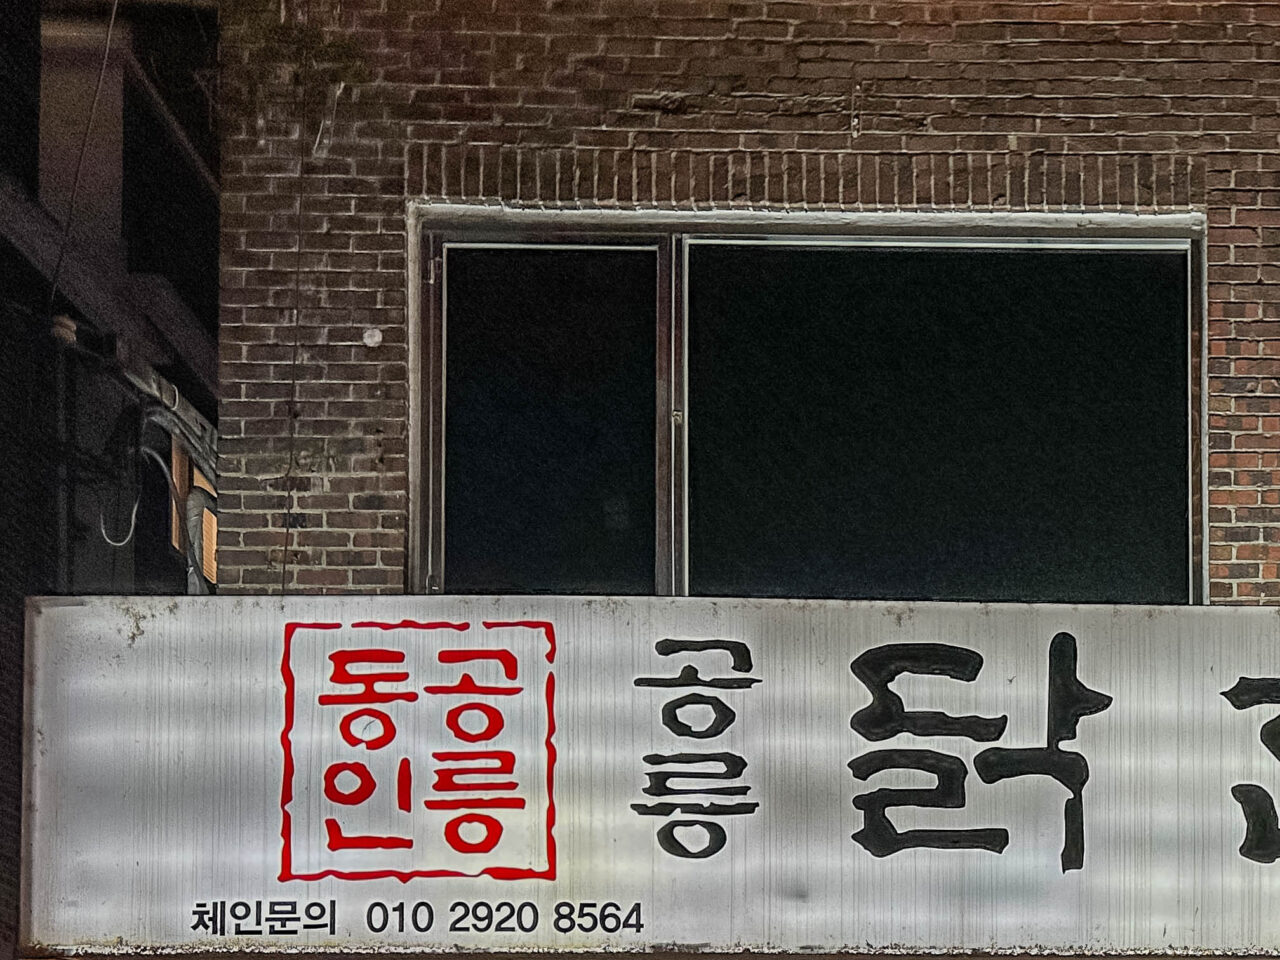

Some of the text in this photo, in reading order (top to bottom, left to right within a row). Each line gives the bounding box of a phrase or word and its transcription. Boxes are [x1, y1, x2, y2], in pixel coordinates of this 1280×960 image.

[630, 638, 763, 860] 공릉
[191, 901, 645, 937] 체인문의 010 2920 8564
